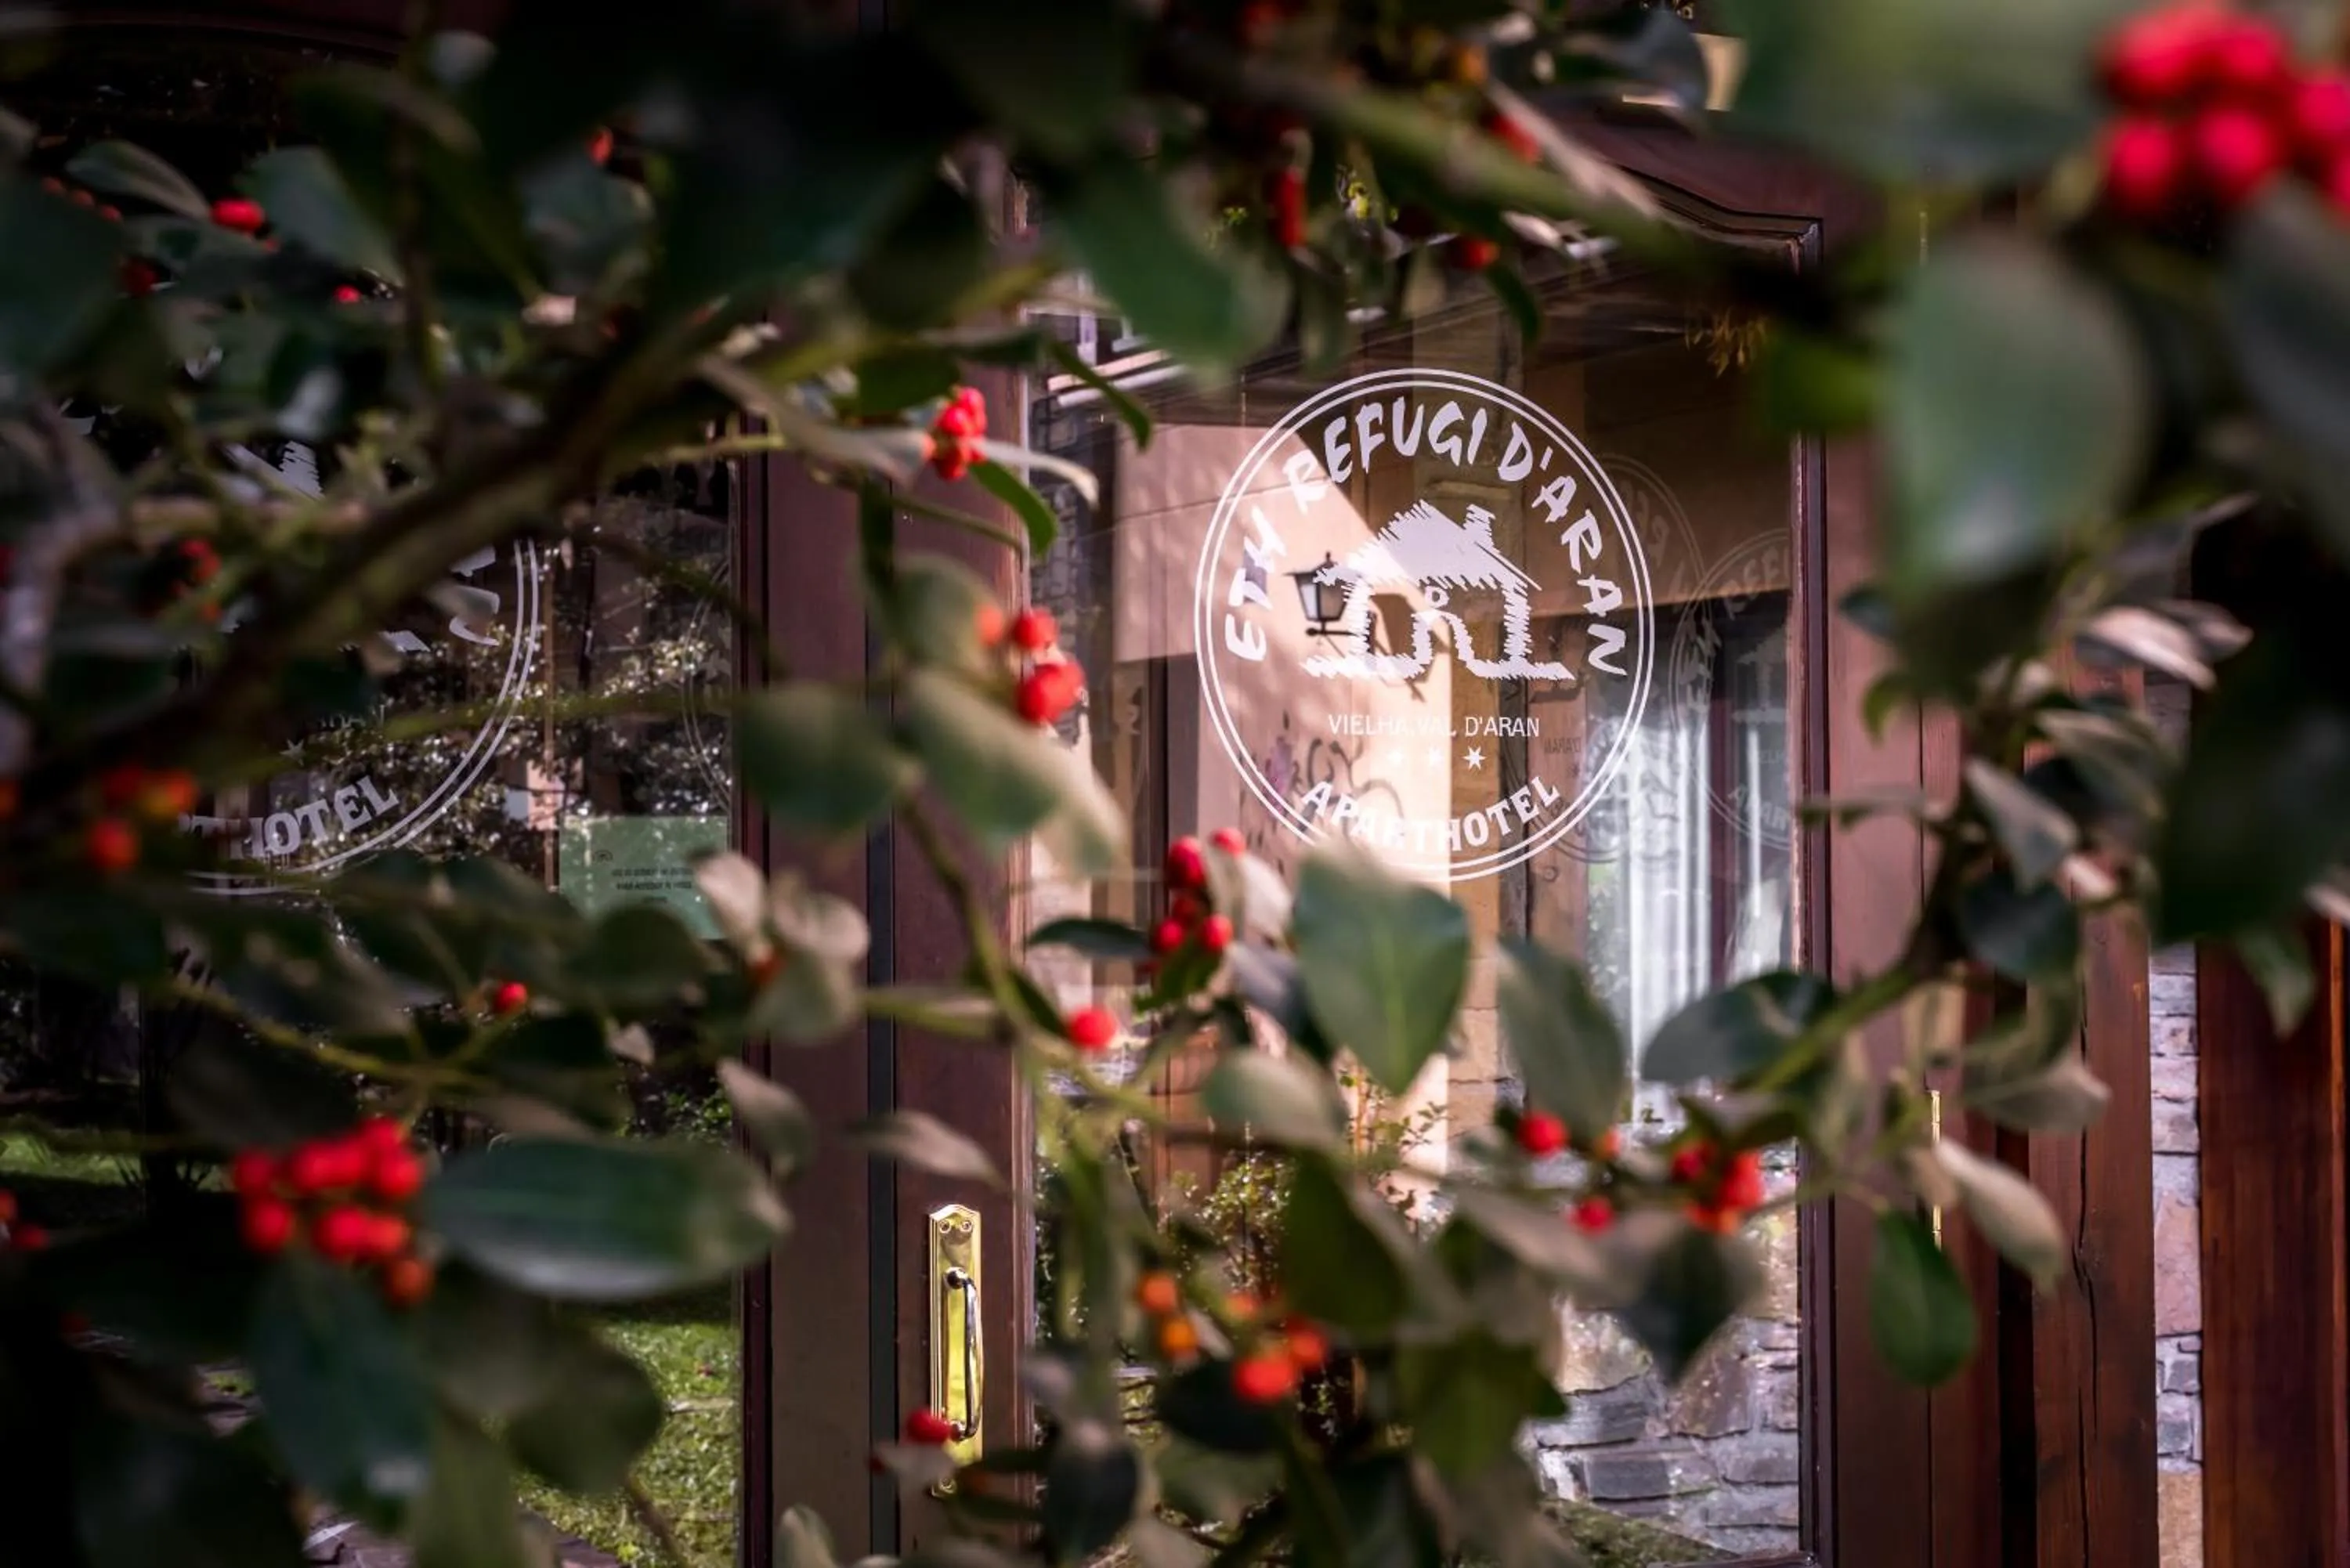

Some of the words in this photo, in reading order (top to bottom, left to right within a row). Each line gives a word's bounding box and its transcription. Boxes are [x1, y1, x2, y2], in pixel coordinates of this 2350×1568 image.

[1224, 505, 1287, 661] ETH
[1282, 396, 1488, 514] REFUGI
[1498, 421, 1628, 676] D'ARAN
[1465, 716, 1539, 737] D'ARAN
[1300, 776, 1560, 851] APARTHOTEL
